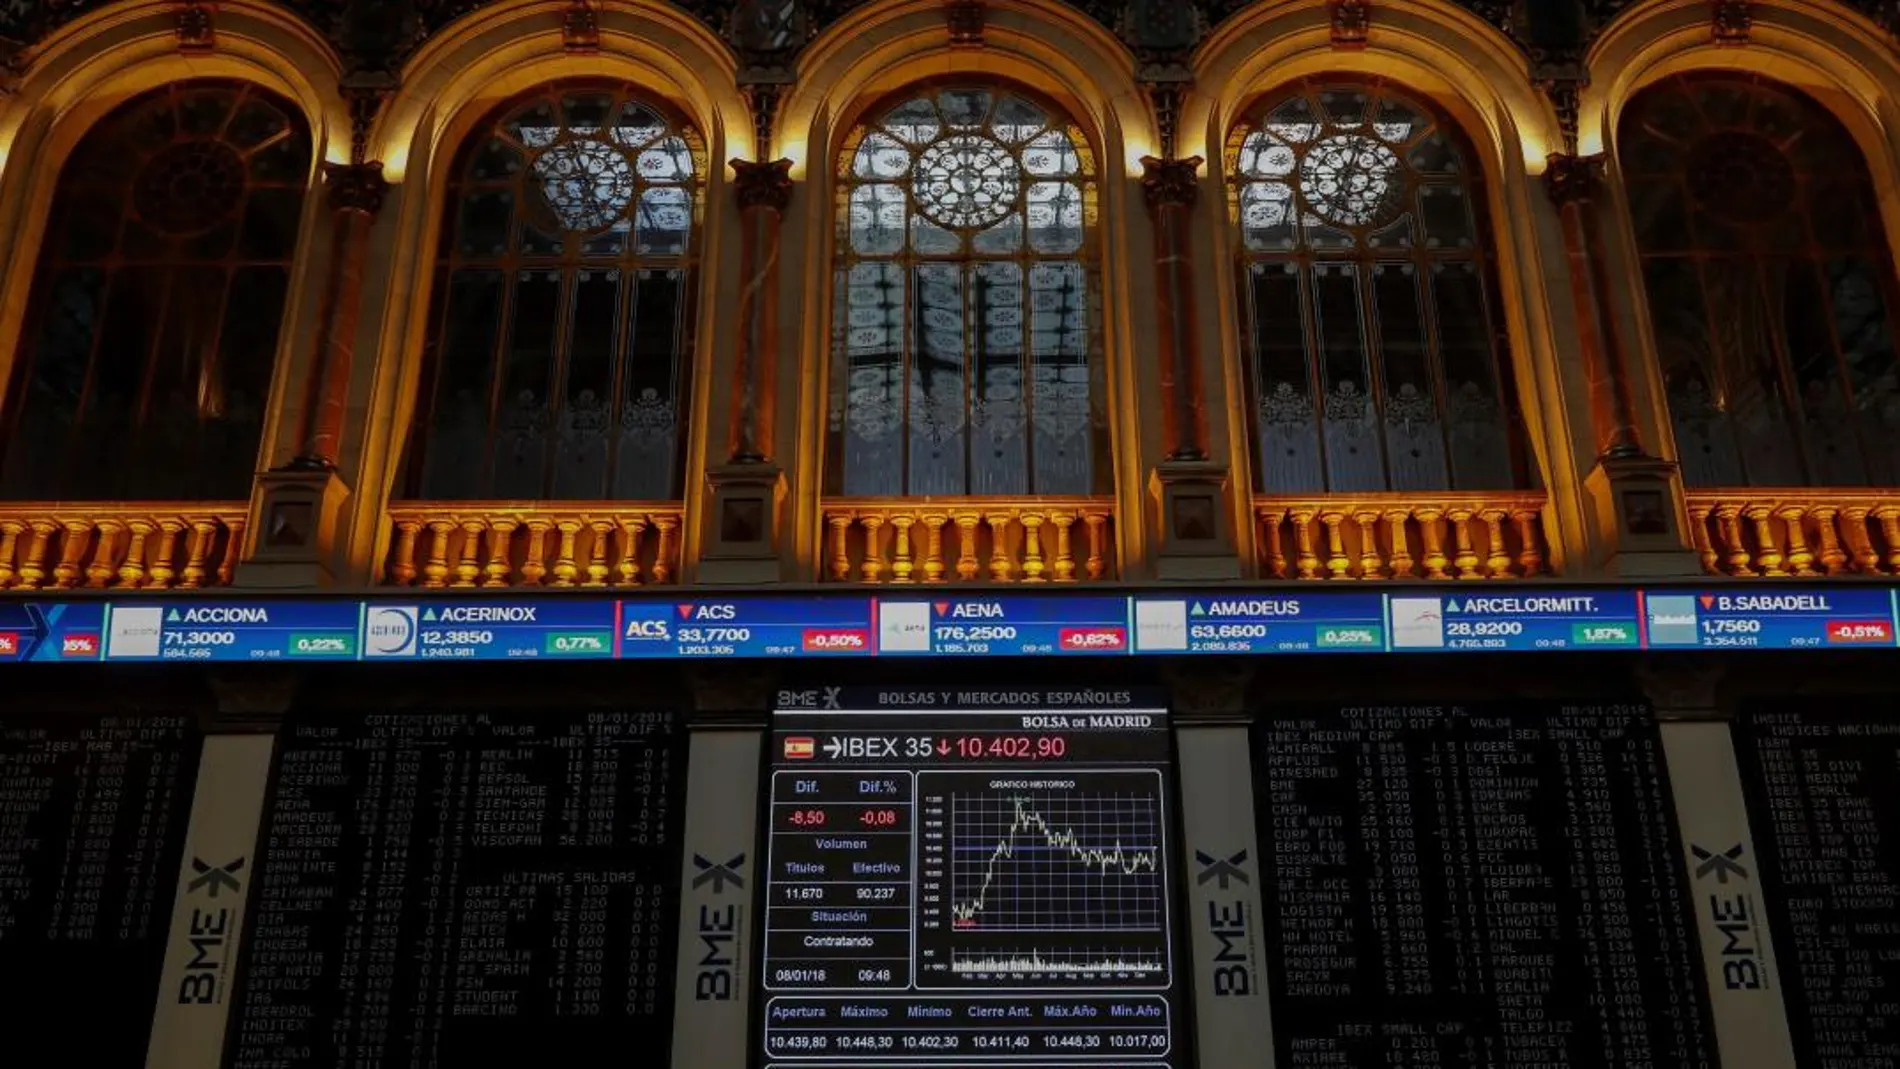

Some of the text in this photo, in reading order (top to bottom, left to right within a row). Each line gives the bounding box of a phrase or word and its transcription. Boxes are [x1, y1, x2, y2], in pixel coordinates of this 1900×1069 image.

[952, 602, 1005, 618] AENA
[1208, 600, 1301, 616] AMADEUS
[1464, 597, 1599, 613] ARCELORMITT.
[1718, 595, 1833, 612] B.SABADELL
[183, 607, 269, 623] ACCIONA
[439, 606, 537, 622] ACERINOX
[695, 605, 736, 619] ACS
[626, 620, 668, 637] ACS
[934, 626, 1017, 641] 176,2500
[1190, 624, 1267, 639] 63,6600
[1446, 621, 1524, 637] 28,9200
[1702, 619, 1761, 634] 1,7560
[1834, 625, 1885, 639] -0,51%
[163, 631, 235, 646] 71,3000
[420, 630, 493, 645] 12,3850
[555, 636, 602, 650] 0,77%
[677, 627, 751, 644] 33,7700
[808, 634, 864, 648] -0,50%
[1065, 633, 1121, 647] -0,62%
[297, 637, 346, 652] 0,22%
[878, 689, 1132, 705] BOLSAS Y MERCADOS ESPAÑOLES
[1022, 716, 1069, 729] BOLSA
[1089, 715, 1152, 729] MADRID
[842, 736, 1067, 760] IBEX 35 10.402,90
[795, 780, 898, 793] Dif. Dif.%
[788, 811, 897, 826] -8,50 -0,08
[816, 838, 868, 850] Volumen
[852, 861, 901, 874] Efectivo
[785, 887, 897, 900] 11.670 90.237
[811, 910, 868, 923] Situación
[803, 935, 875, 948] Contratando
[1208, 900, 1250, 996] BME
[1710, 893, 1761, 990] BME
[177, 908, 227, 1005] BME
[696, 904, 734, 1001] BME
[775, 969, 892, 983] 08/01/18 09:48
[772, 1005, 827, 1020] Apertura
[840, 1004, 889, 1018] Máximo
[968, 1004, 1005, 1018] Cierre
[1008, 1004, 1034, 1018] Ant.
[770, 1035, 828, 1050] 10.439,80
[902, 1035, 960, 1050] 10.402,30
[971, 1035, 1031, 1049] 10.411,40
[1108, 1034, 1167, 1049] 10.017,00
